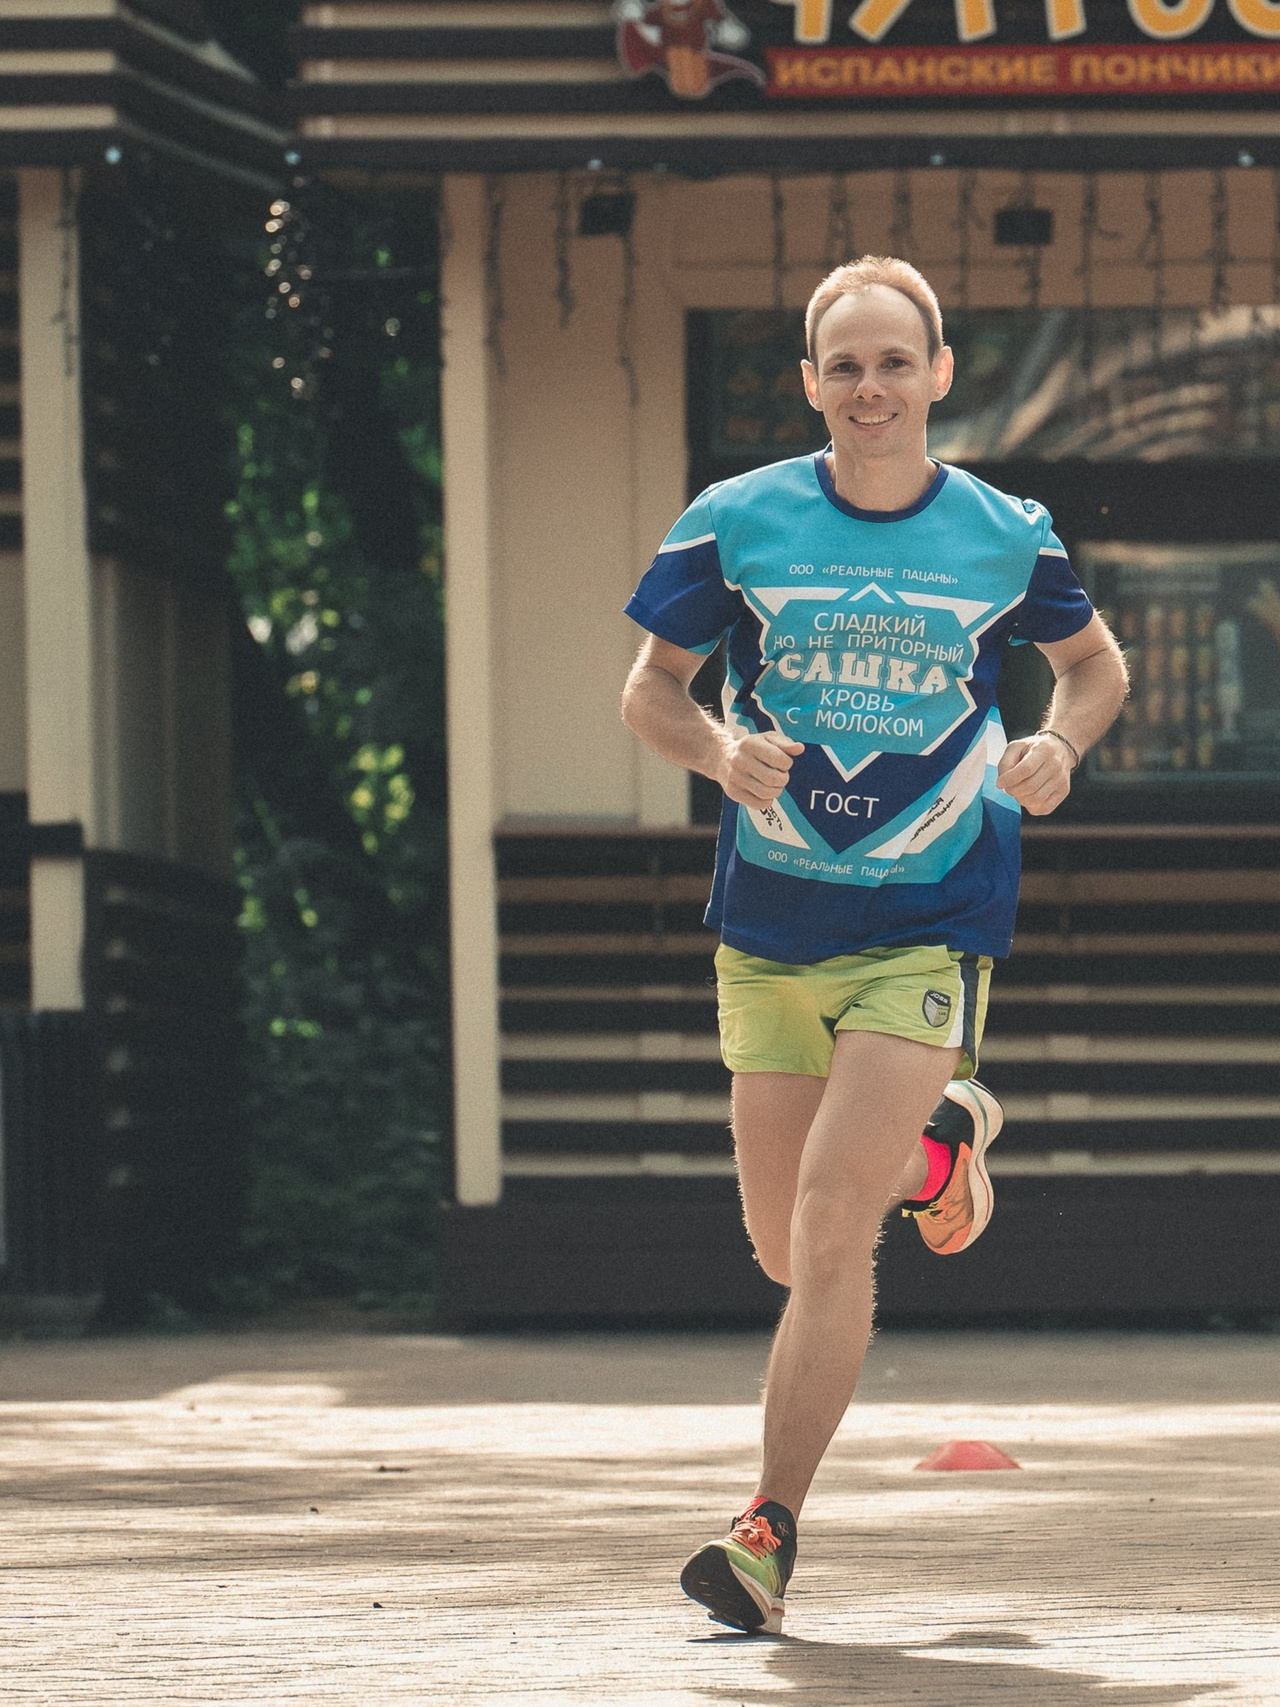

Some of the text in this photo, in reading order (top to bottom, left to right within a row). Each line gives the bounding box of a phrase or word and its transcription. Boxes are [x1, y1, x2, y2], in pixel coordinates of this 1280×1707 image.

[774, 55, 1058, 87] ИСПАНСКИЕ
[788, 564, 958, 585] ООО «РЕАЛЬНЫЕ ПАЦАНЫ»
[814, 612, 927, 638] СЛАДКИЙ
[773, 634, 965, 663] НО НЕ ПРИТОРНЫЙ
[776, 651, 951, 695] САШКА
[820, 688, 895, 712] КРОВЬ
[786, 707, 924, 738] С МОЛОКОМ
[809, 789, 880, 819] ГОСТ
[768, 850, 788, 863] ООО
[793, 857, 854, 875] «РЕАЛЬНЫЕ
